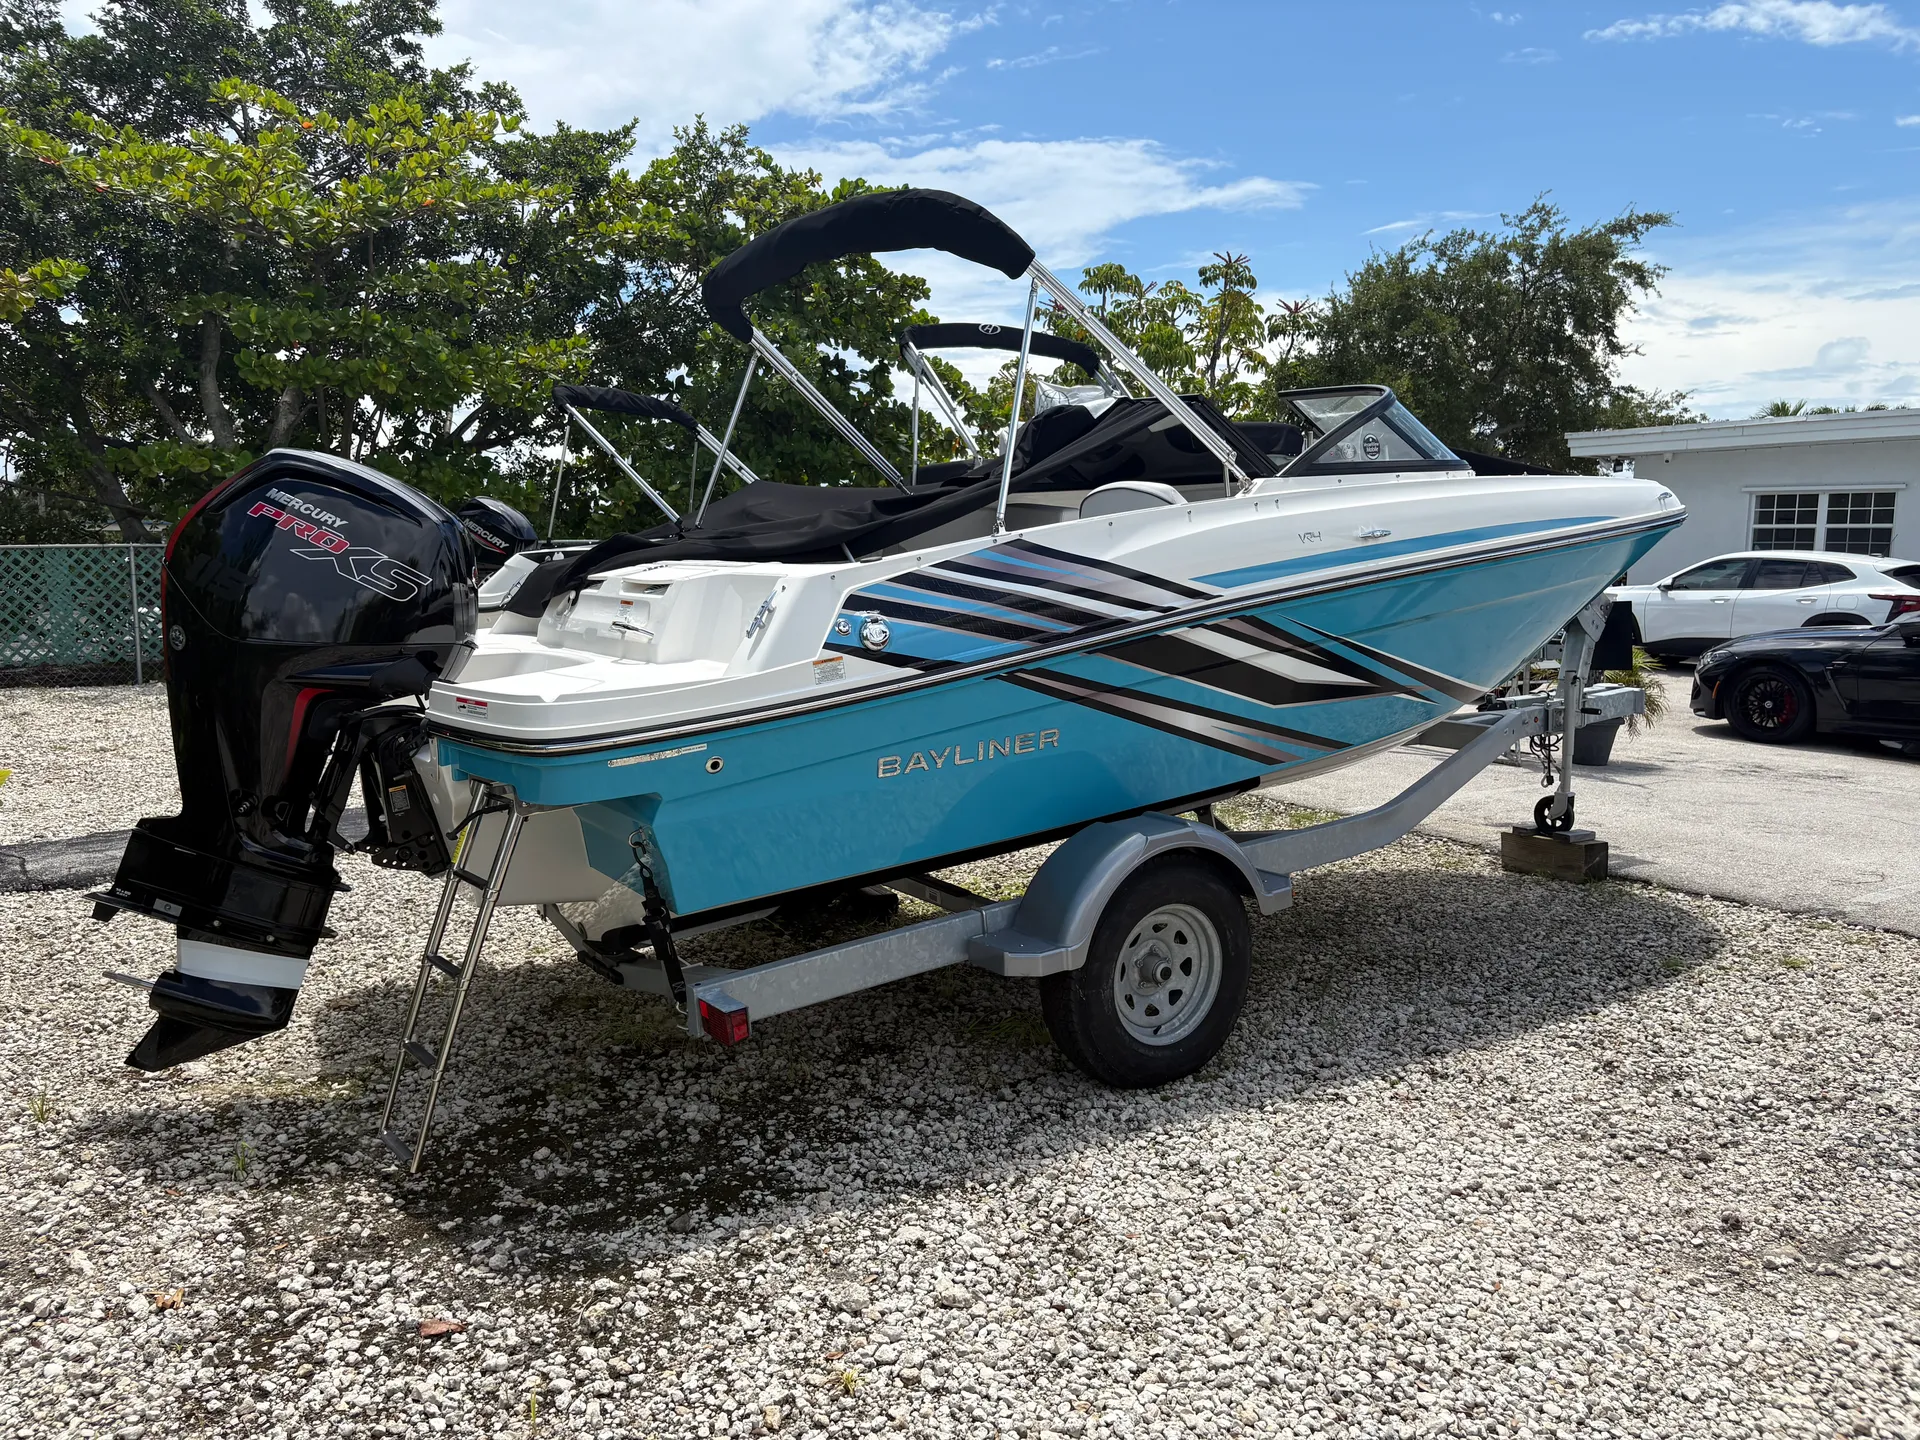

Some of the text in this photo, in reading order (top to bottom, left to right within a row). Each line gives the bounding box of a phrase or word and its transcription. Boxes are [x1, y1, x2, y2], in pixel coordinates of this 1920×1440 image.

[265, 488, 349, 528] MERCURY
[247, 501, 433, 602] PRO XS
[463, 518, 510, 549] MERCURY
[877, 728, 1060, 779] BAYLINER
